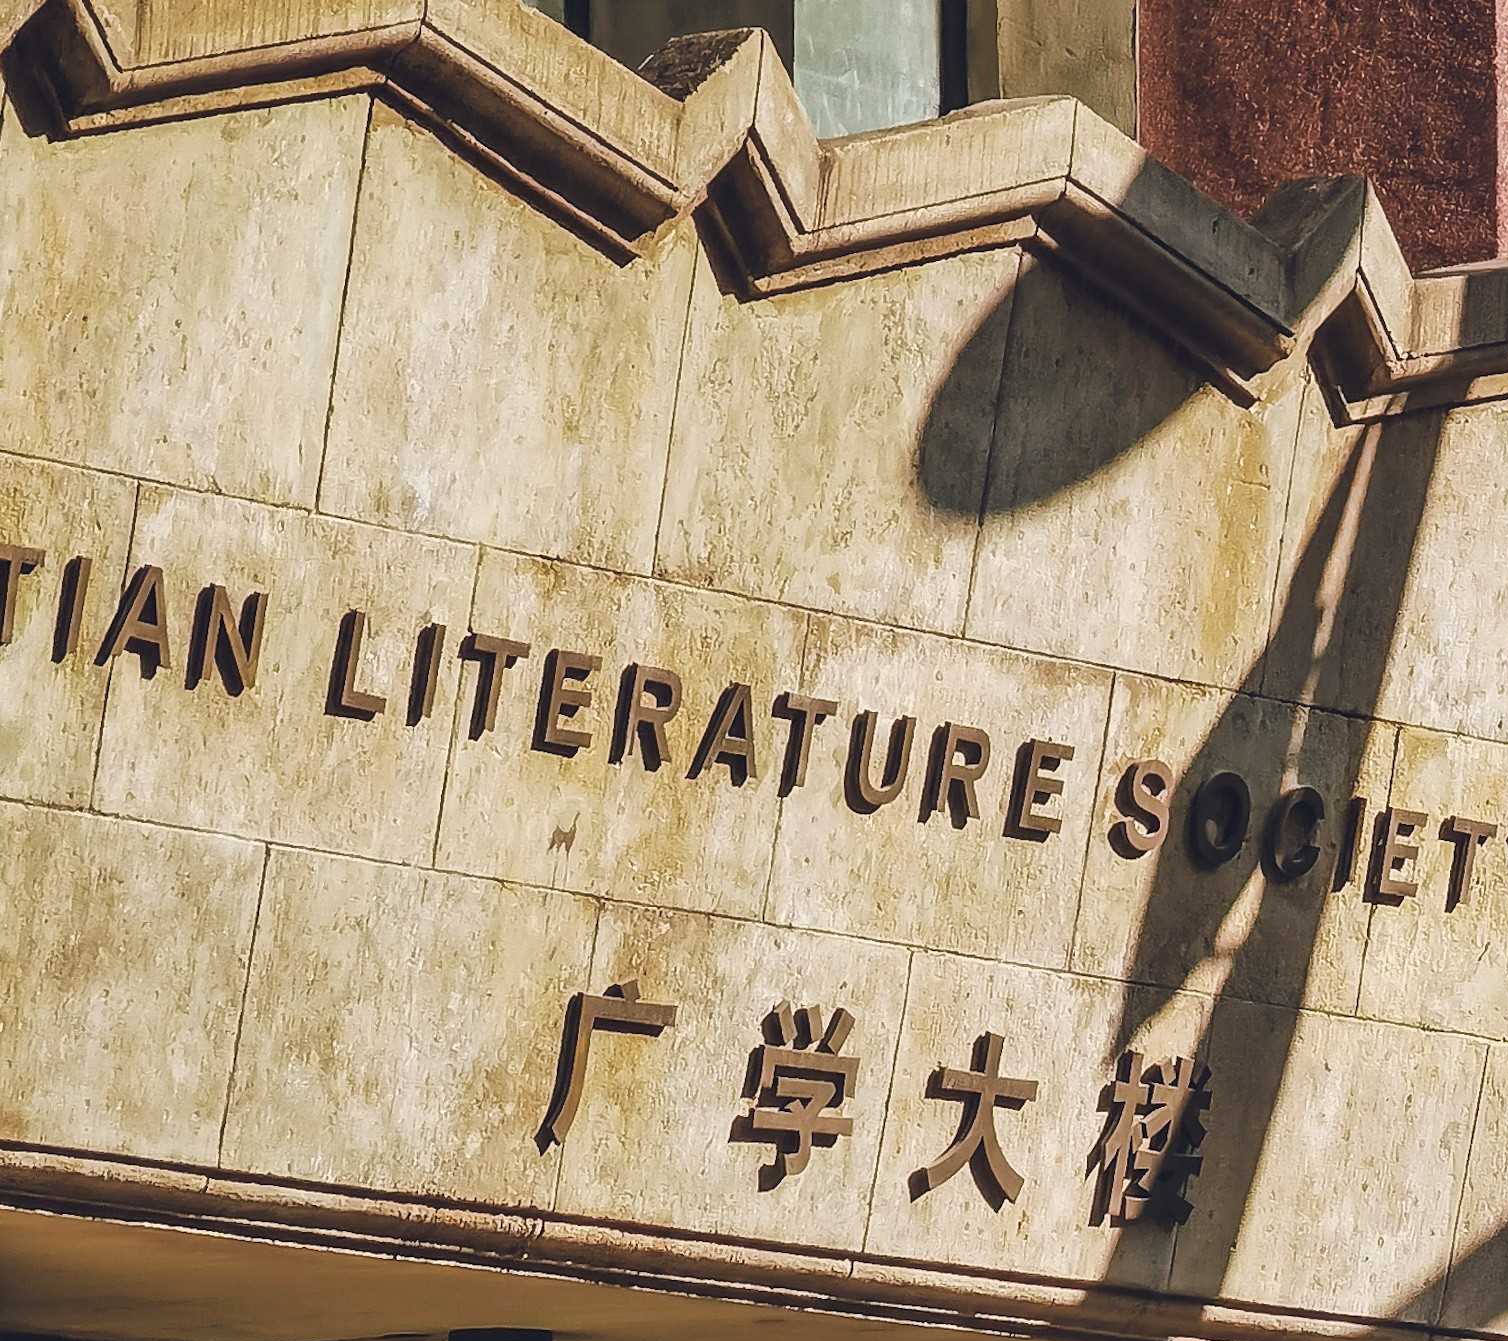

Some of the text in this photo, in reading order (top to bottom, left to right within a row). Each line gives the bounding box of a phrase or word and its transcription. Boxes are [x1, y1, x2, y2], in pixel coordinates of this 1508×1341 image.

[325, 607, 1075, 841] LITERATURE
[533, 978, 1213, 1229] 广学大楼
